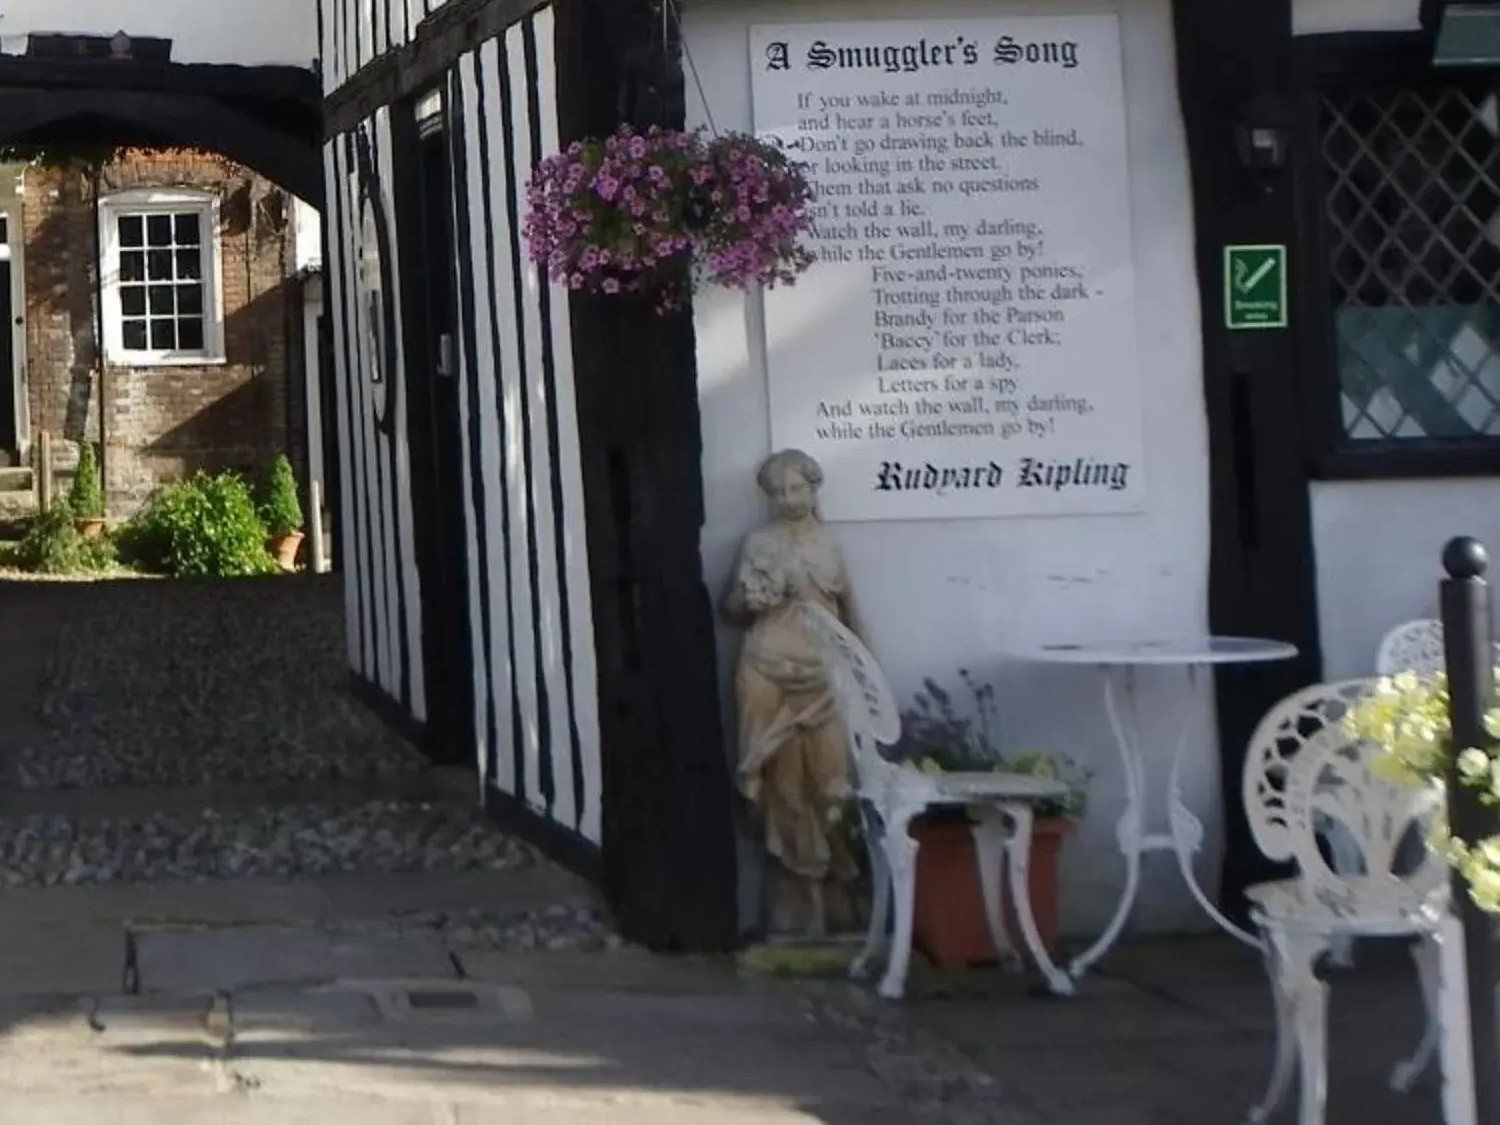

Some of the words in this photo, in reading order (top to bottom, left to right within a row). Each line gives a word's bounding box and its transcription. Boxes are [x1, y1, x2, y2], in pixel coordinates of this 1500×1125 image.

[766, 41, 791, 70] A
[807, 36, 978, 72] Smuggler's
[994, 36, 1079, 68] Song
[798, 91, 812, 108] If
[820, 96, 850, 111] you
[857, 91, 899, 106] wake
[905, 92, 920, 106] at
[798, 113, 829, 130] and
[836, 113, 874, 129] hear
[880, 118, 889, 129] a
[896, 109, 955, 127] horse's
[800, 134, 847, 152] Don't
[855, 139, 876, 155] go
[879, 133, 947, 153] drawing
[954, 131, 994, 148] back
[1001, 130, 1027, 147] the
[825, 156, 890, 176] looking
[896, 156, 912, 171] in
[918, 155, 946, 171] the
[858, 178, 891, 194] that
[897, 176, 925, 193] ask
[932, 180, 953, 193] no
[959, 176, 1040, 195] questions
[846, 199, 878, 216] told
[884, 205, 894, 216] a
[864, 221, 891, 238] the
[897, 219, 939, 238] wall,
[943, 223, 967, 240] my
[858, 244, 885, 260] the
[890, 242, 984, 260] Gentlemen
[990, 246, 1012, 262] go
[1017, 240, 1044, 261] by!
[872, 264, 1011, 283] Five-and-twenty
[872, 286, 940, 307] Trotting
[946, 285, 1012, 305] through
[1018, 284, 1045, 300] the
[1050, 283, 1089, 299] dark
[874, 309, 933, 329] Brandy
[943, 307, 966, 325] for
[973, 307, 1001, 324] the
[1007, 306, 1066, 323] Parson
[943, 330, 966, 347] for
[973, 329, 1000, 346] the
[877, 353, 927, 372] Laces
[931, 351, 957, 369] for
[963, 357, 972, 369] a
[878, 375, 939, 393] Letters
[945, 374, 967, 392] for
[975, 379, 983, 390] a
[990, 378, 1016, 393] spy
[816, 401, 852, 418] And
[858, 399, 909, 416] watch
[915, 397, 942, 415] the
[995, 400, 1019, 416] my
[816, 422, 863, 440] while
[868, 422, 895, 439] the
[901, 420, 995, 438] Gentlemen
[1002, 423, 1022, 440] go
[1027, 417, 1055, 438] by!
[873, 461, 1003, 496] Rudyard
[1016, 457, 1130, 492] Kipling
